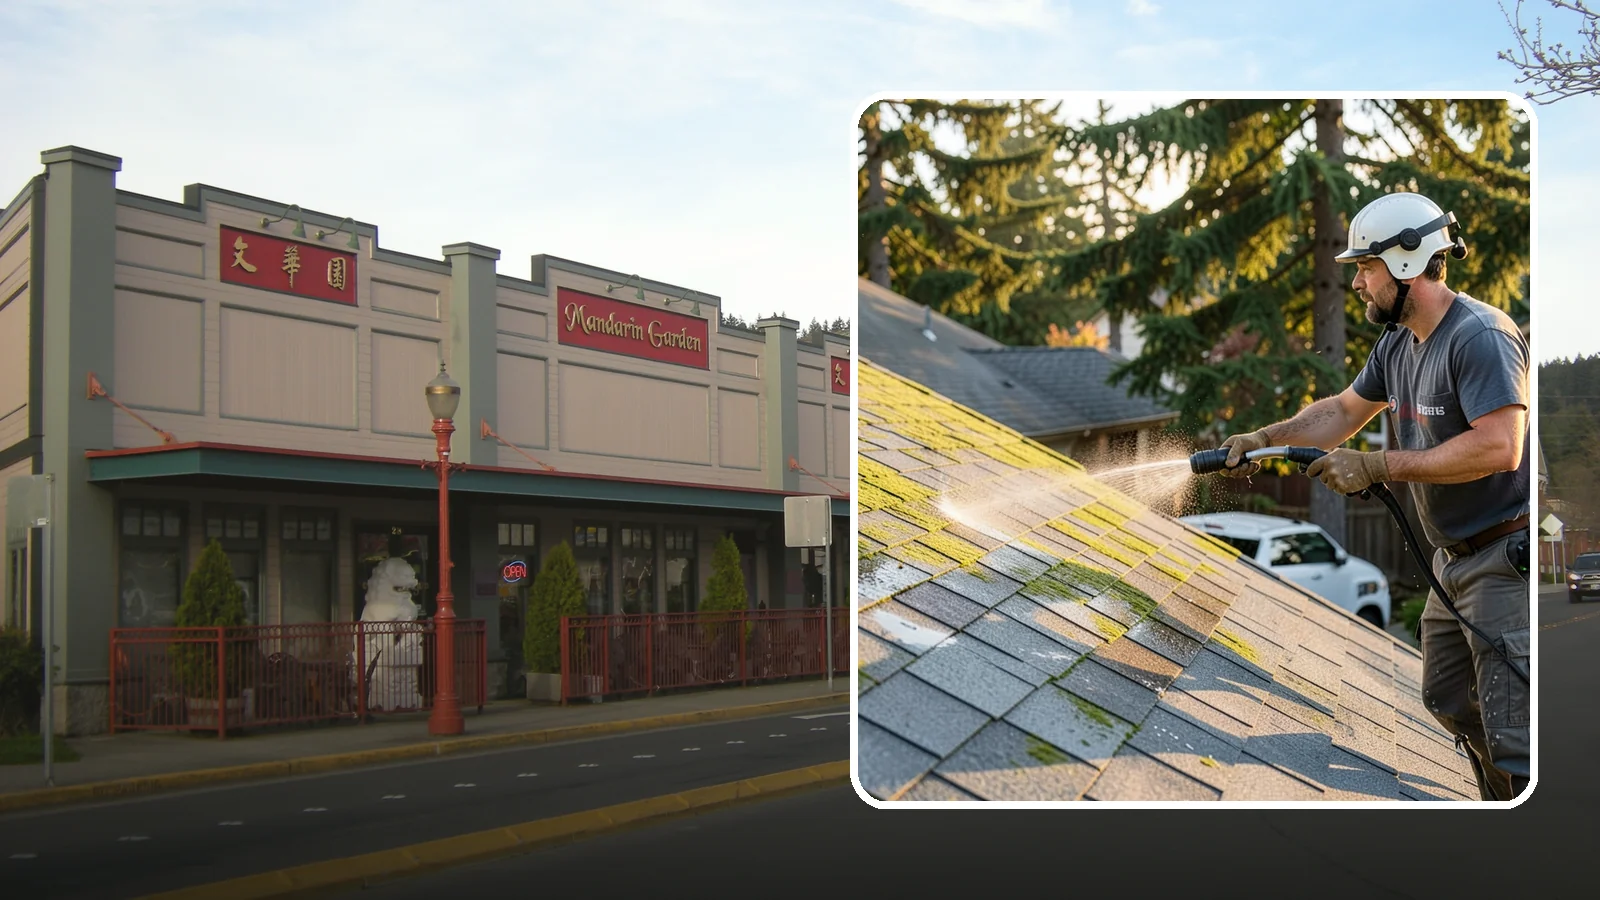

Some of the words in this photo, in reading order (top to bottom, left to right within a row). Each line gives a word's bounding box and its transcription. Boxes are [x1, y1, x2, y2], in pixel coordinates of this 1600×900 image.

[231, 235, 347, 291] 文華園
[564, 302, 644, 340] Mandarin
[648, 320, 702, 352] Garden
[504, 565, 527, 579] OPEN
